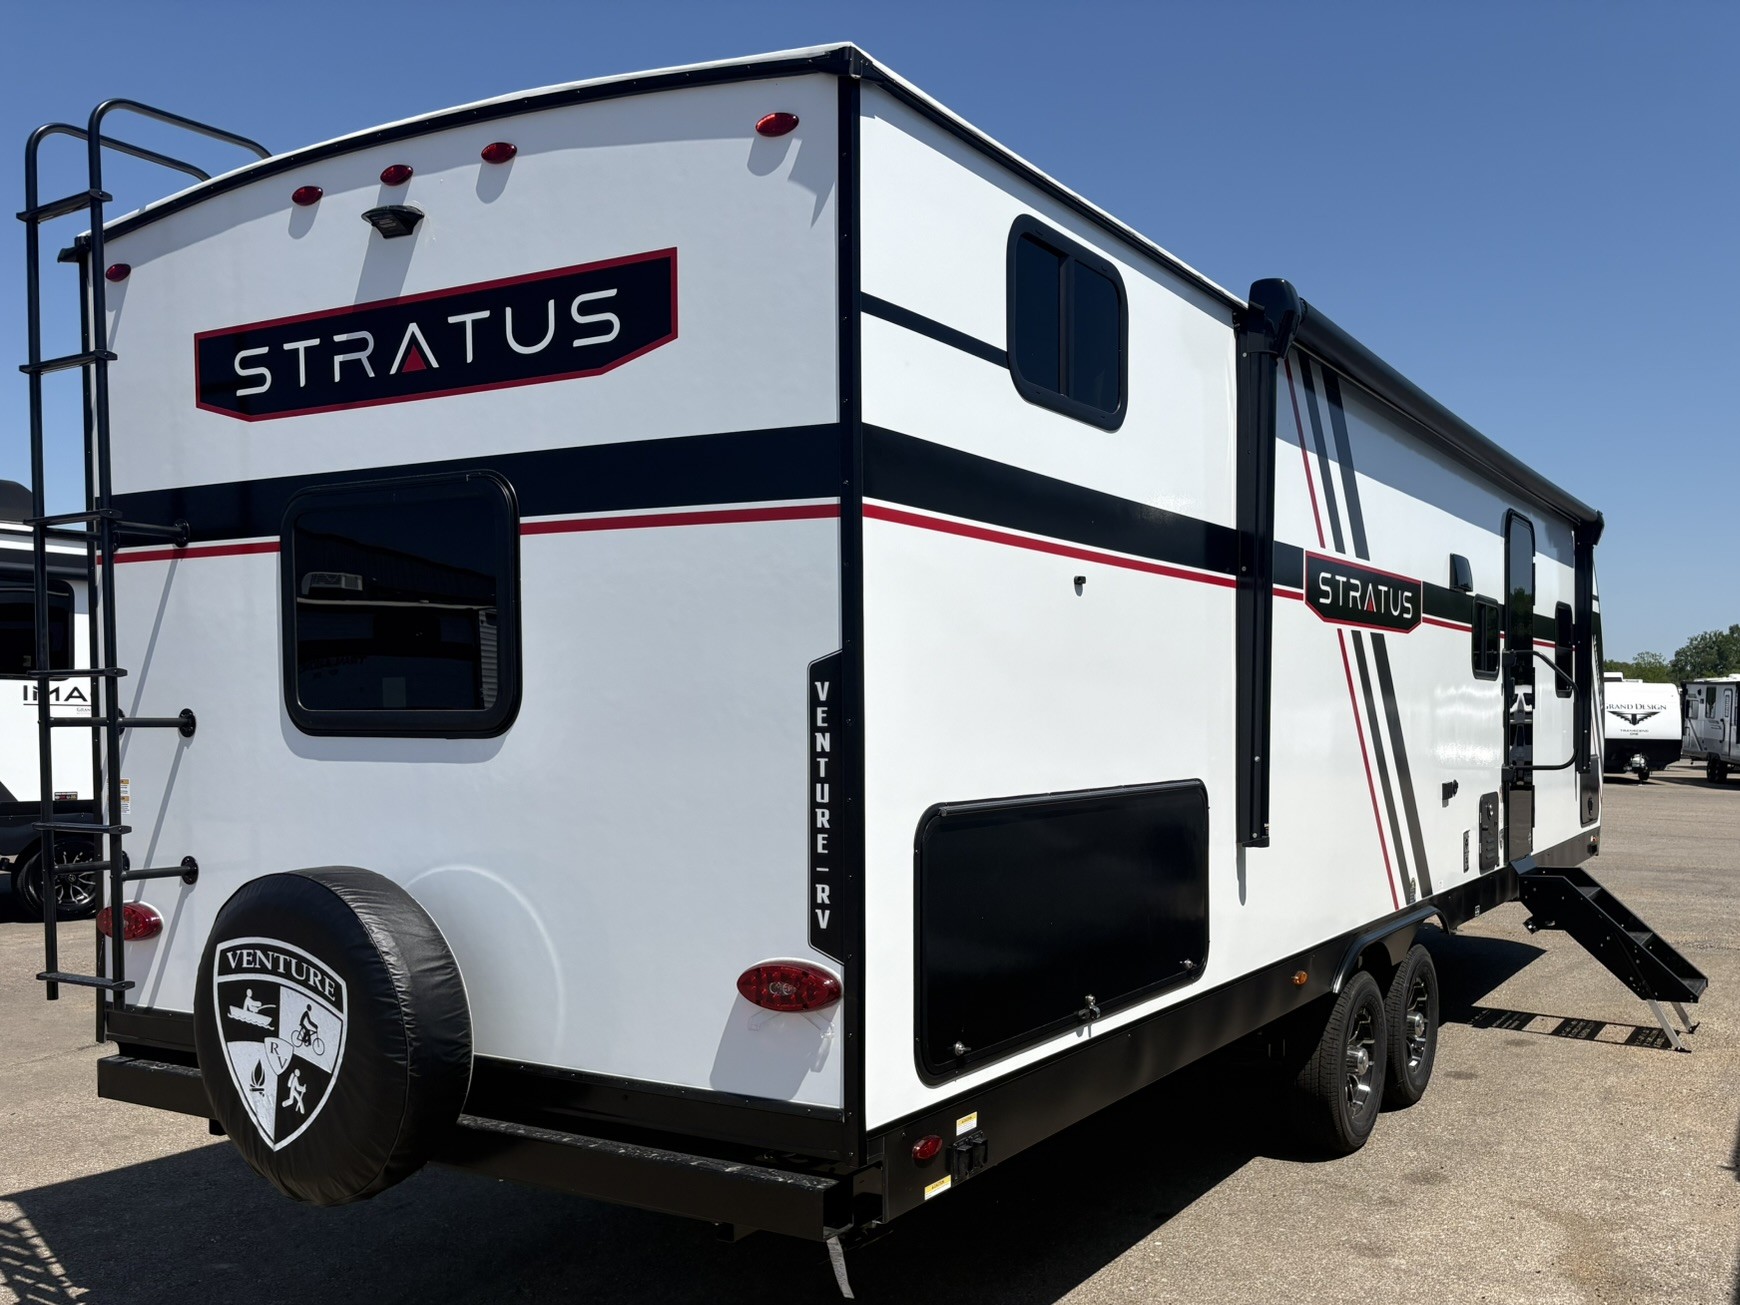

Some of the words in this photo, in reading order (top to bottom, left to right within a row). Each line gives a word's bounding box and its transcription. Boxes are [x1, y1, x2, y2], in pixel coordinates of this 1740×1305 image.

[233, 288, 621, 397] STRATUS
[1318, 571, 1413, 619] STRATUS
[23, 684, 92, 702] IMA
[815, 681, 831, 929] VENTURE-RV
[226, 949, 336, 1001] VENTURE
